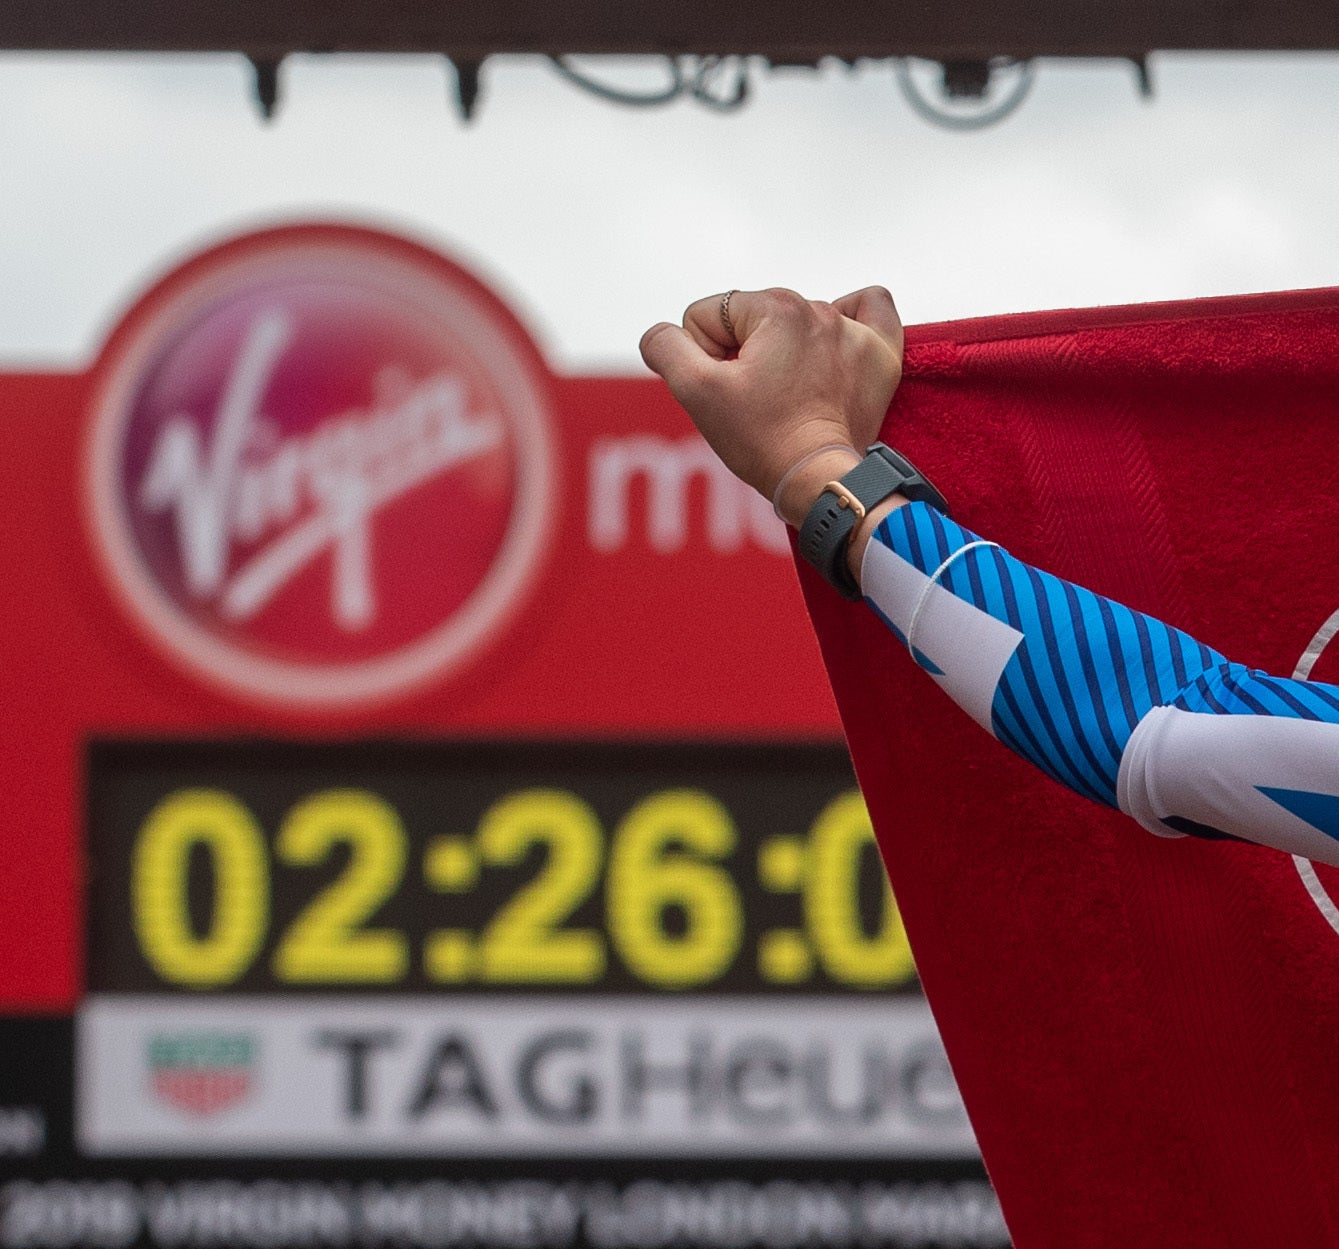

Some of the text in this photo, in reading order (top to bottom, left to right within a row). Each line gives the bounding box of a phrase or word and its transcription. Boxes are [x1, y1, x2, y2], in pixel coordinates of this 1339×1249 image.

[141, 303, 503, 632] Virgin
[143, 1180, 352, 1249] VIRGIN
[361, 1180, 578, 1249] MONEY
[586, 1180, 852, 1249] LONDON
